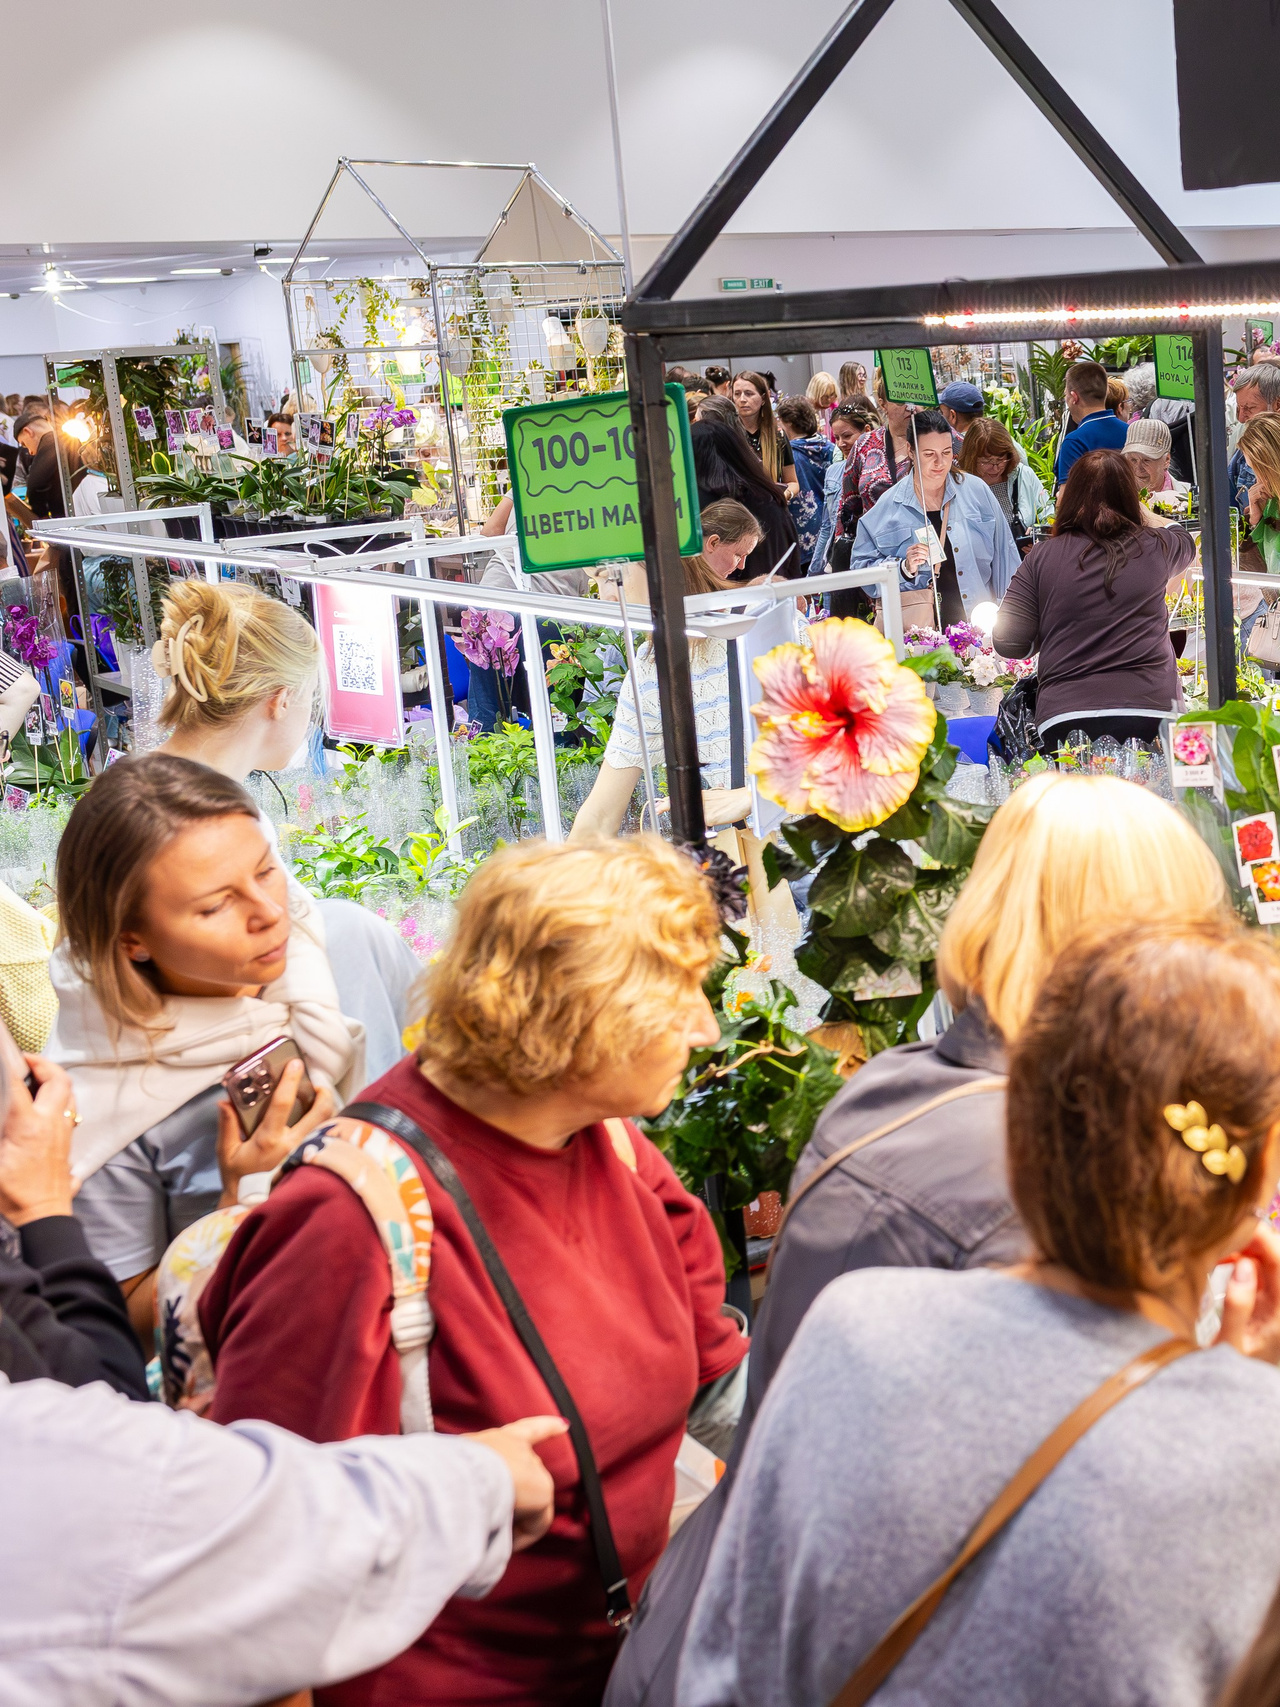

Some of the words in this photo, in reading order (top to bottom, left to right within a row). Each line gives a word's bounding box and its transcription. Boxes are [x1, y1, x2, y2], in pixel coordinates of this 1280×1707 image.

[753, 279, 769, 289] EXIT
[896, 357, 912, 371] 113
[892, 381, 919, 390] ФИАЛКИ
[1160, 371, 1193, 387] HOYA_V_
[889, 390, 935, 402] ПОДМОСКОВЬЕ
[531, 424, 636, 472] 100-10
[523, 507, 595, 540] ЦВЕТЫ
